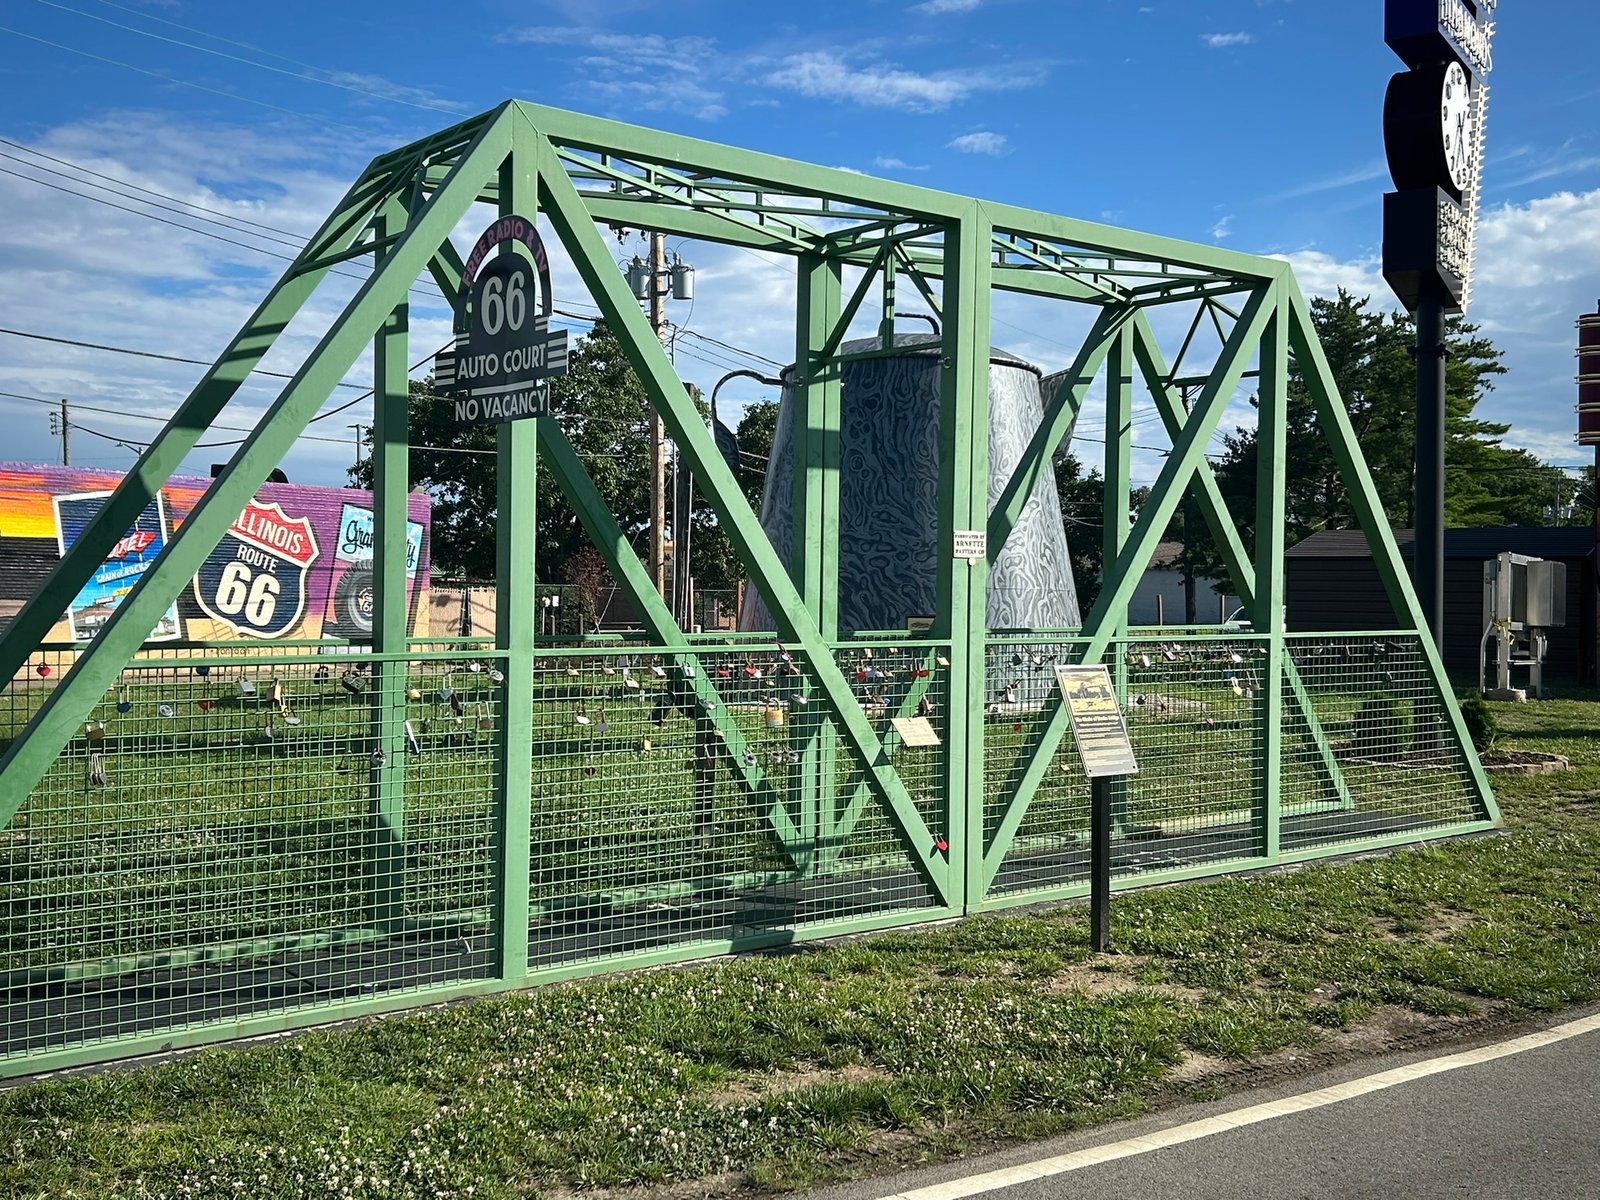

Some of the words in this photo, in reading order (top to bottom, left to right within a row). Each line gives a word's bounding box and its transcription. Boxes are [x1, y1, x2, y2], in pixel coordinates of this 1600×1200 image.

[462, 238, 487, 287] FREE
[487, 220, 524, 247] RADIO
[526, 229, 534, 249] &
[535, 243, 548, 272] TV
[481, 270, 526, 336] 66
[457, 352, 499, 380] AUTO
[502, 343, 546, 374] COURT
[454, 399, 479, 422] NO
[482, 388, 546, 420] VACANCY
[231, 508, 304, 554] LLINOIS
[96, 570, 116, 583] CHAIN
[236, 543, 280, 574] ROUTE
[215, 561, 281, 627] 66
